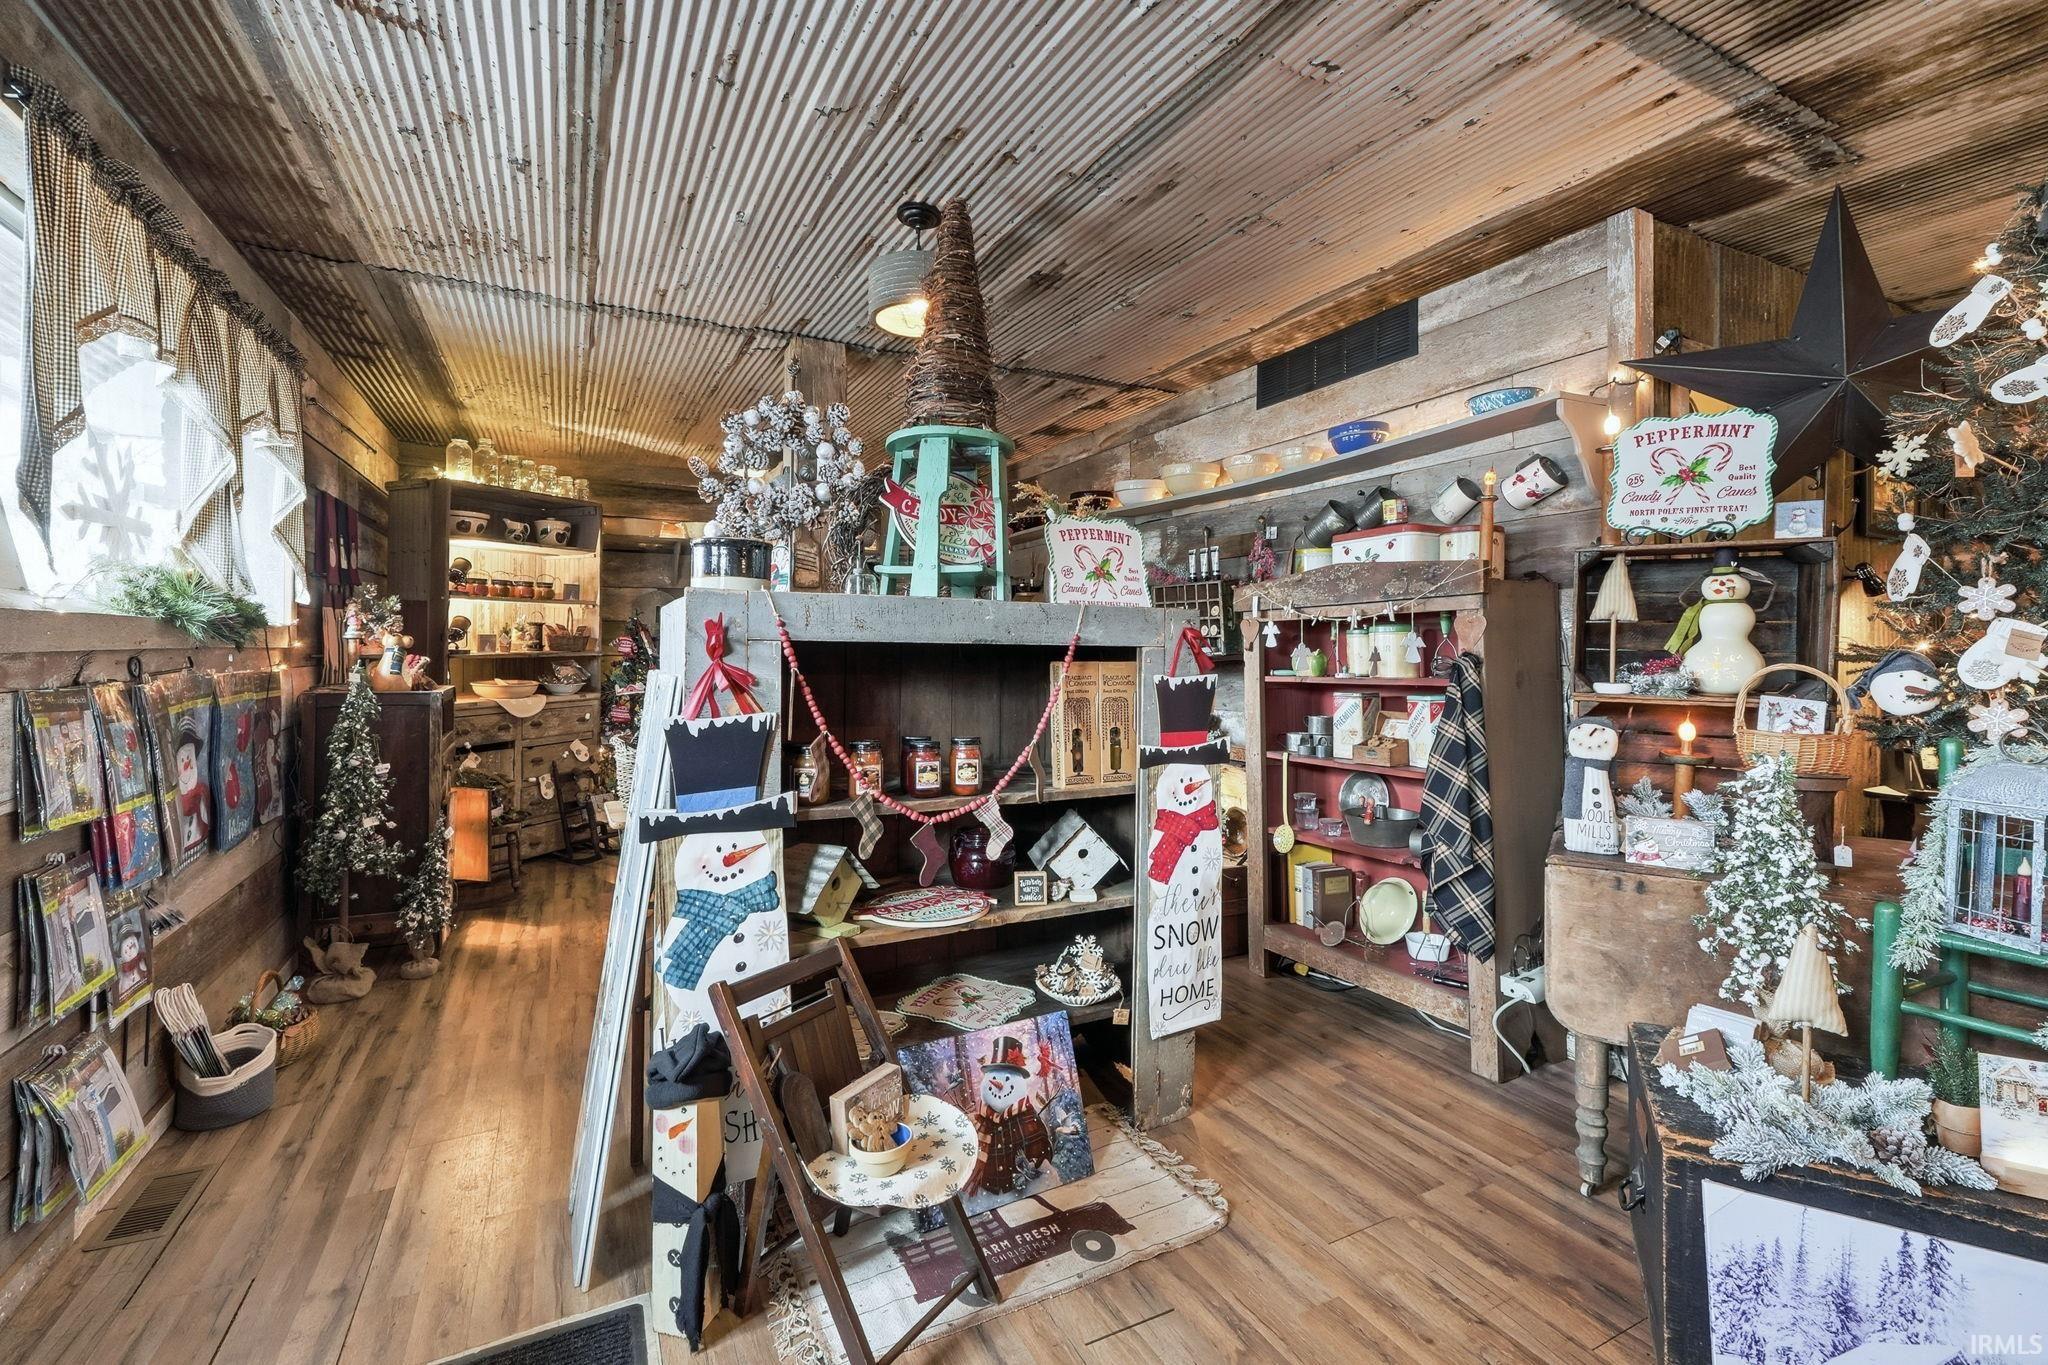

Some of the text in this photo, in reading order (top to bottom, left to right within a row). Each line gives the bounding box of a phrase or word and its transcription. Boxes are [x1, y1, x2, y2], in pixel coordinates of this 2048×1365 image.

[1634, 423, 1755, 448] PEPPERMINT
[1728, 473, 1757, 481] Quality
[1621, 489, 1662, 504] Candy
[1717, 485, 1758, 498] Canes
[901, 498, 958, 523] CADY
[1629, 504, 1748, 517] NORTH POLE'S FINEST TREAT!
[1059, 528, 1132, 546] PEPPERMINT
[1061, 582, 1088, 595] Candy
[1120, 586, 1143, 596] Canes
[1333, 700, 1361, 731] PREMIUM
[1577, 823, 1612, 841] MILLS
[1157, 884, 1220, 917] there's
[1154, 915, 1219, 950] SNOW
[1153, 946, 1220, 984] place like
[1160, 978, 1215, 1007] HOME
[982, 1223, 1061, 1257] ARM FRESH
[991, 1236, 1057, 1264] CHRISTMAS
